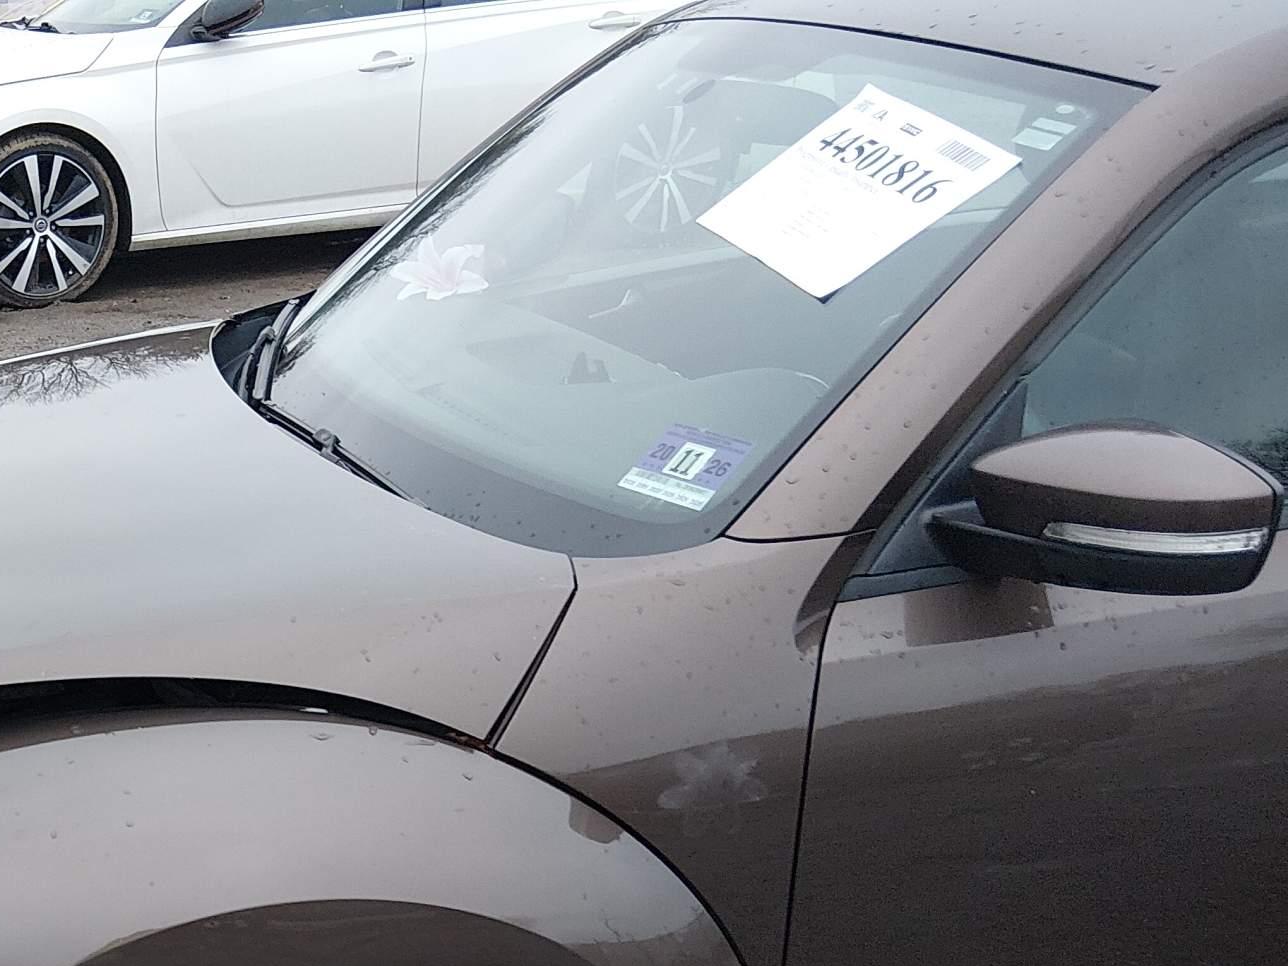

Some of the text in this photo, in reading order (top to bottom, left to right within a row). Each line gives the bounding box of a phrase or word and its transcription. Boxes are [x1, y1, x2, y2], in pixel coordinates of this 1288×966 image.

[819, 128, 954, 204] 44501816
[649, 443, 676, 461] 20
[668, 449, 705, 477] 11
[703, 459, 732, 477] 26
